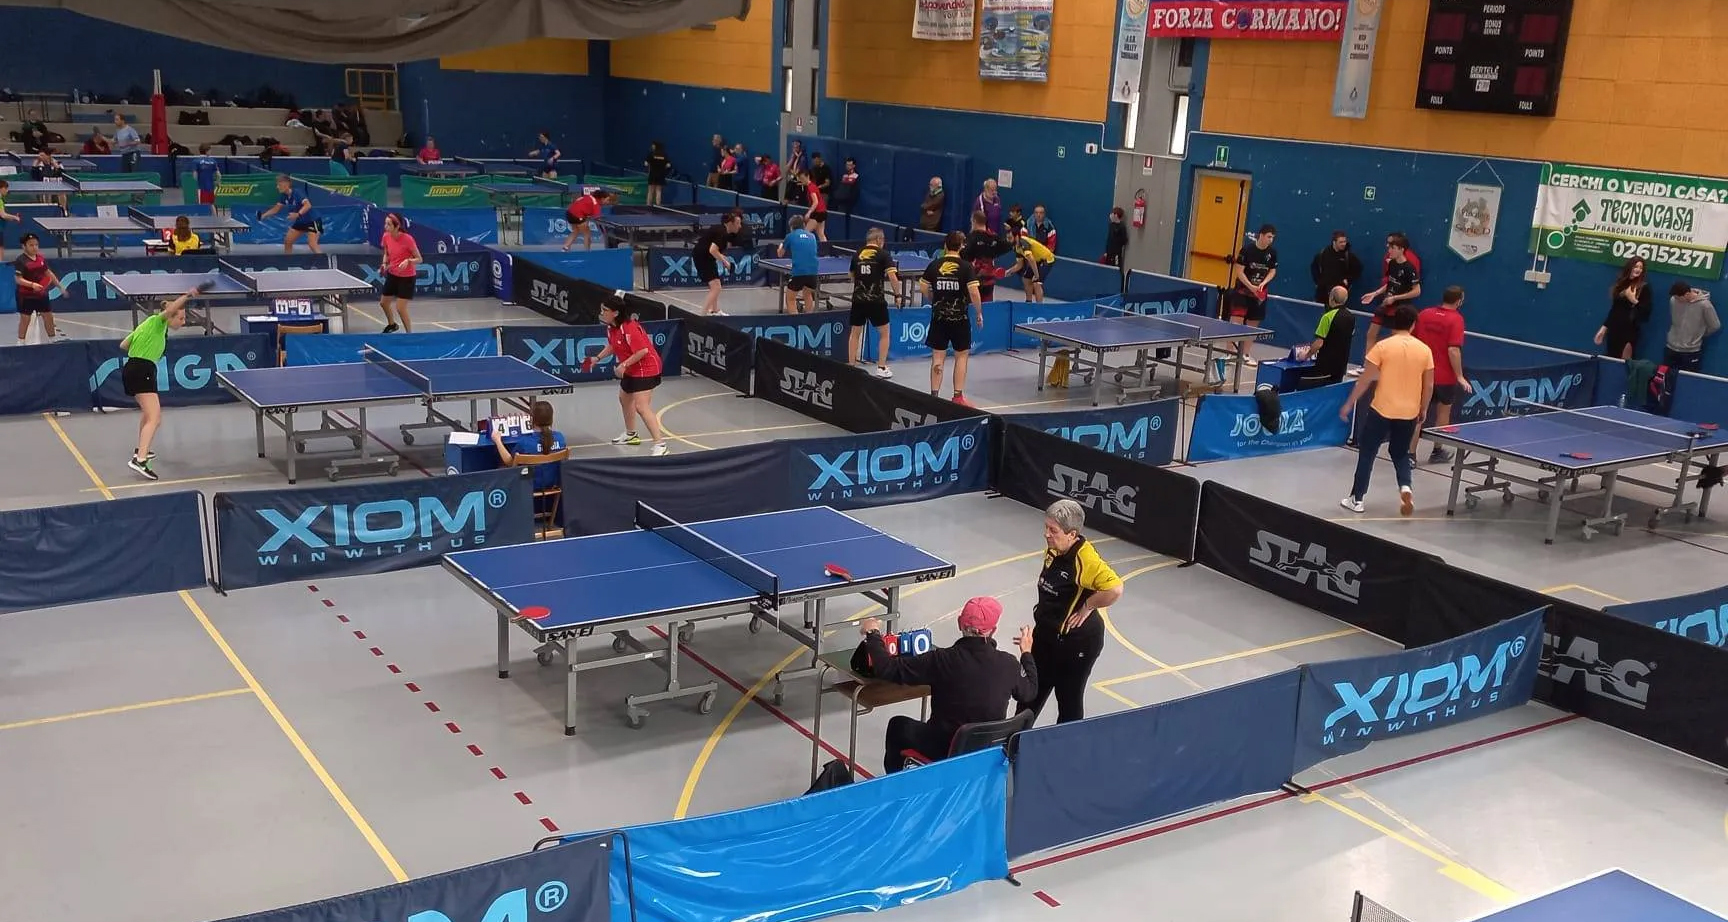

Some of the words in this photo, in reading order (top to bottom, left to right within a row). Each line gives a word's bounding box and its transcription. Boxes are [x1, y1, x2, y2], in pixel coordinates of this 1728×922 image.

[1152, 8, 1214, 30] FORZA
[1483, 4, 1506, 13] PERIODS
[1434, 46, 1454, 55] POINTS
[1524, 49, 1545, 58] POINTS
[1551, 173, 1603, 191] CERCHI
[1606, 178, 1619, 192] O
[1623, 180, 1671, 197] VENDI
[1674, 185, 1728, 203] CASA?
[1601, 198, 1694, 232] TECNOCASA
[1653, 232, 1694, 243] NETWORK
[1612, 240, 1714, 269] 026152371
[301, 304, 307, 313] 7
[687, 331, 728, 371] STAG
[779, 366, 836, 410] STAG
[498, 422, 505, 434] 4
[808, 489, 852, 501] WIN
[863, 480, 923, 496] WITH
[934, 472, 959, 484] US
[1047, 463, 1138, 524] STAG
[258, 551, 326, 566] WIN
[345, 541, 432, 559] WITH
[450, 535, 486, 548] US
[1249, 529, 1362, 605] STAG
[889, 641, 897, 655] 0
[903, 639, 909, 652] 1
[1388, 706, 1457, 731] WITH
[1471, 692, 1498, 708] US
